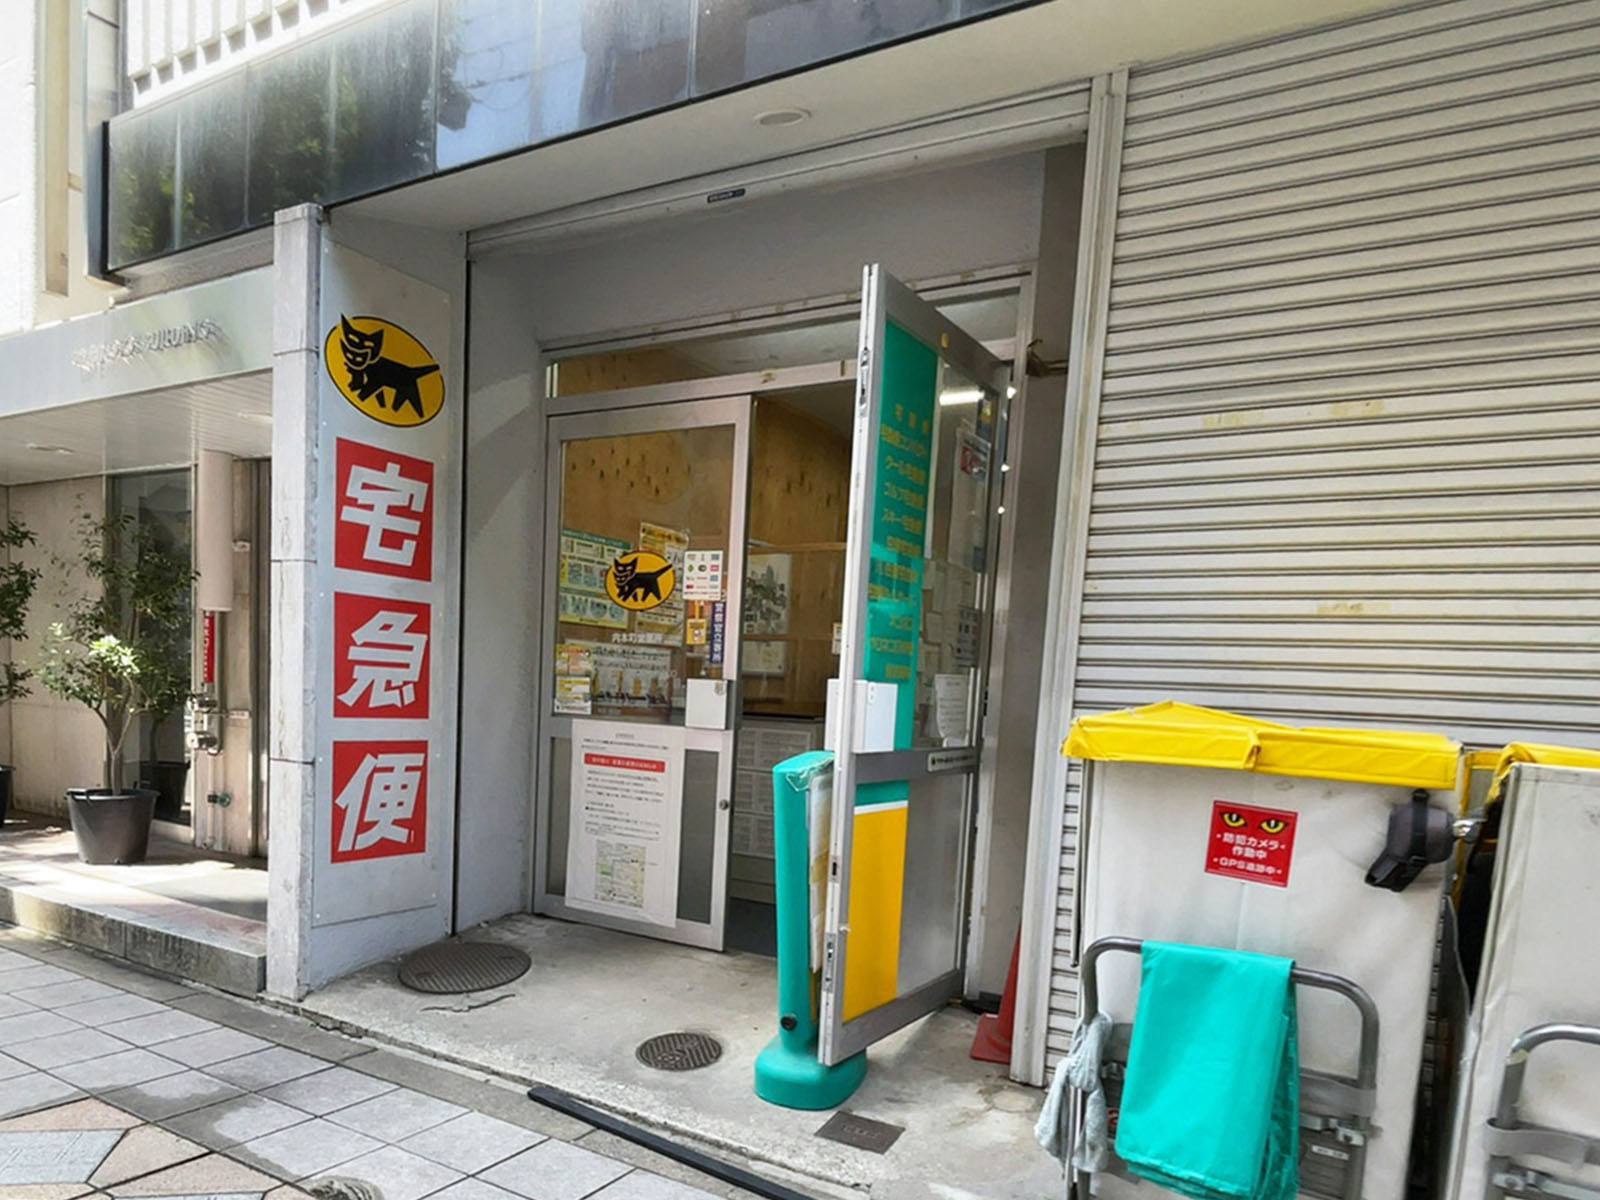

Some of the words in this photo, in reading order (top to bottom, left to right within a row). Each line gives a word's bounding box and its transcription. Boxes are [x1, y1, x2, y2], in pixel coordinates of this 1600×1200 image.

[336, 462, 428, 852] 宅急便
[1232, 846, 1266, 860] 作動中
